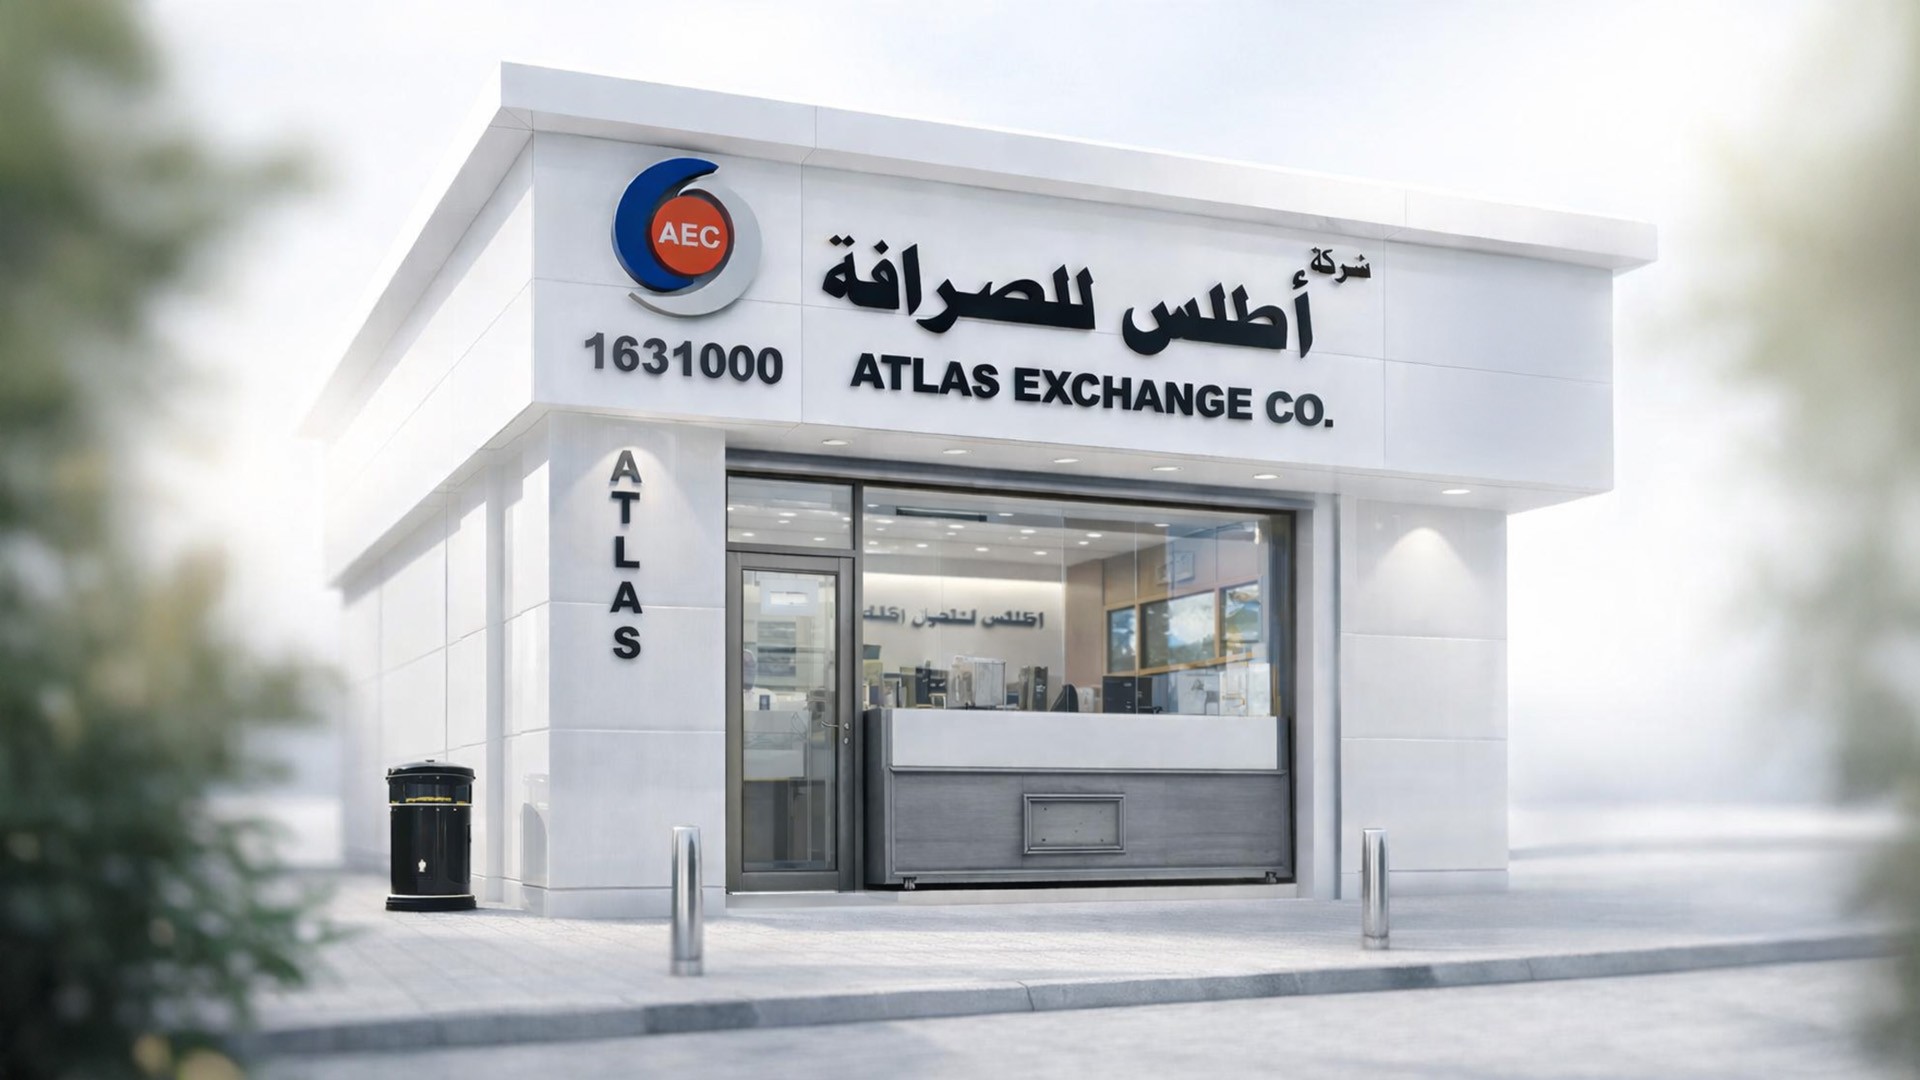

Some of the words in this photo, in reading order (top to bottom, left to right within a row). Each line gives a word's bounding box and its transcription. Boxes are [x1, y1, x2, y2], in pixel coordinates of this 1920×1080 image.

[658, 221, 720, 249] AEC
[1310, 246, 1371, 284] شركة
[821, 234, 1096, 334] للصرافة
[1121, 269, 1313, 358] أطلس
[584, 332, 784, 386] 1631000
[849, 352, 1000, 400] ATLAS
[1013, 366, 1253, 421] EXCHANGE
[1265, 390, 1334, 428] CO.
[610, 449, 643, 660] ATLAS
